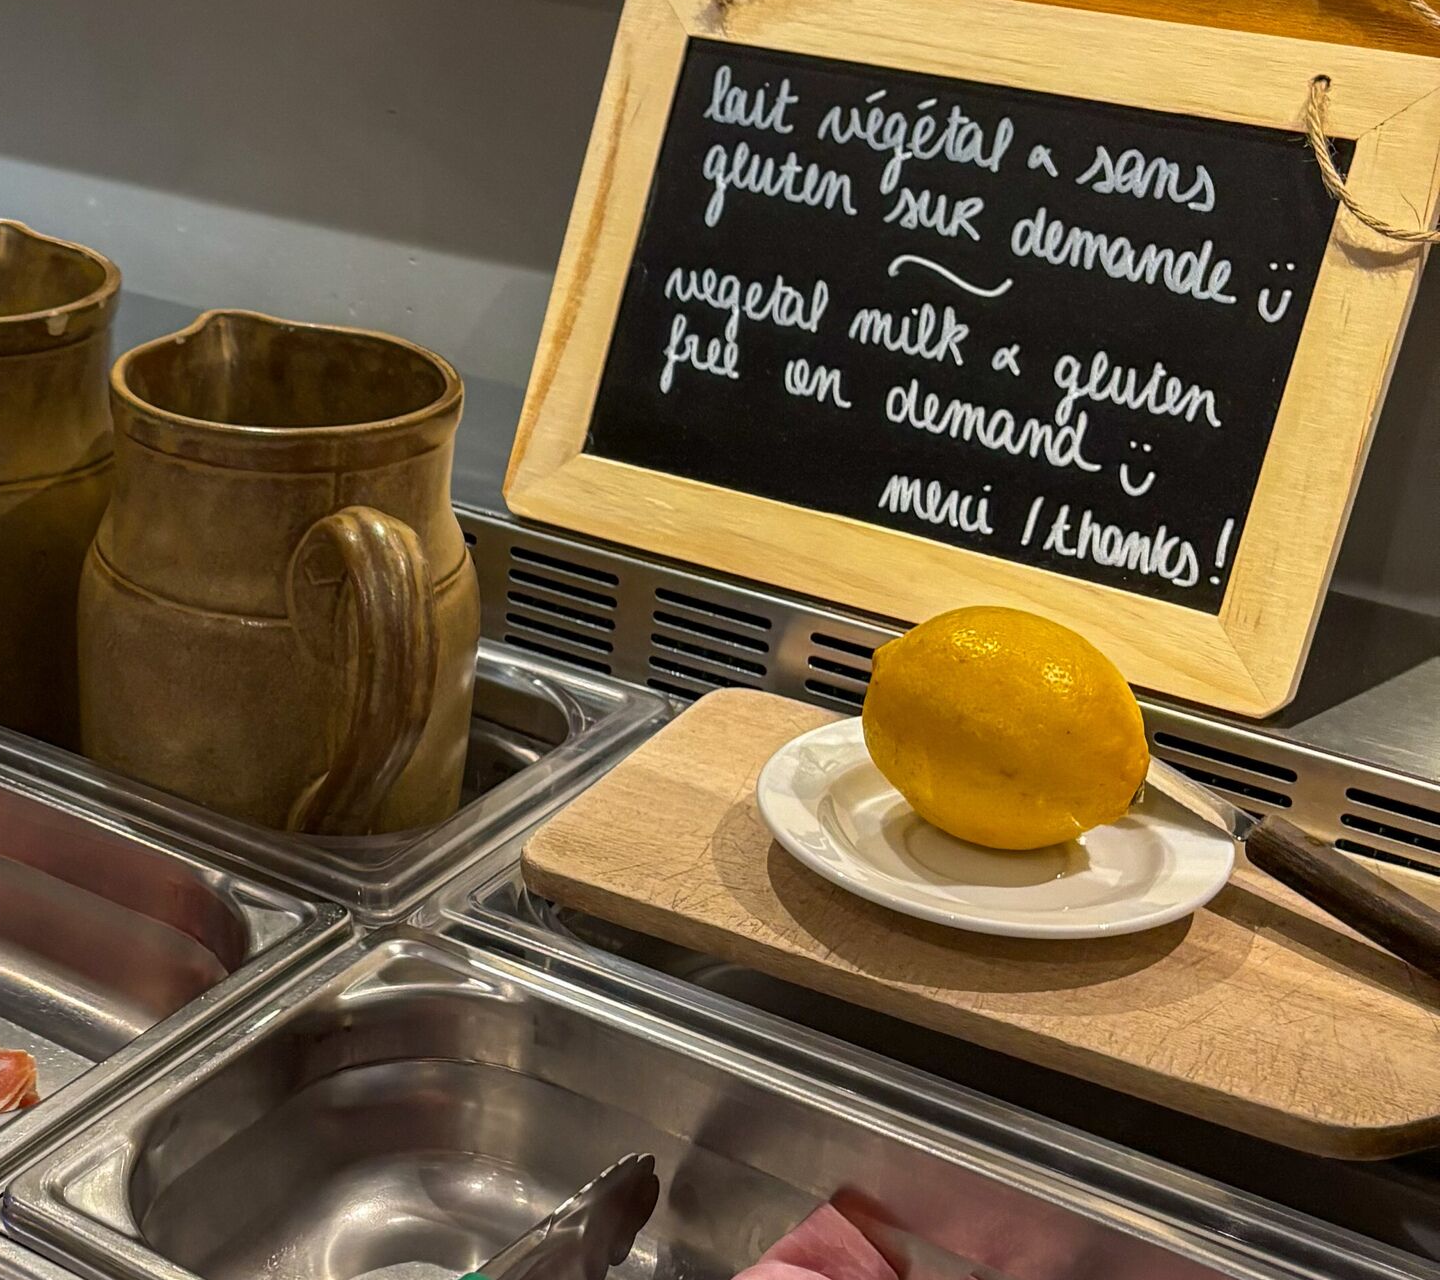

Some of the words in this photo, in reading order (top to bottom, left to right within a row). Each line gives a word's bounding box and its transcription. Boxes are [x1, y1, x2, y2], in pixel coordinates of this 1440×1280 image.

[703, 65, 799, 133] lait
[817, 89, 1014, 195] végétal
[1076, 146, 1215, 211] sans
[703, 141, 857, 227] gluten
[1011, 207, 1237, 304] demande
[660, 314, 739, 394] free
[886, 378, 1103, 472] demand
[664, 268, 829, 342] vegetal
[849, 303, 970, 365] milk
[1054, 350, 1222, 428] gluten
[878, 475, 994, 535] merci
